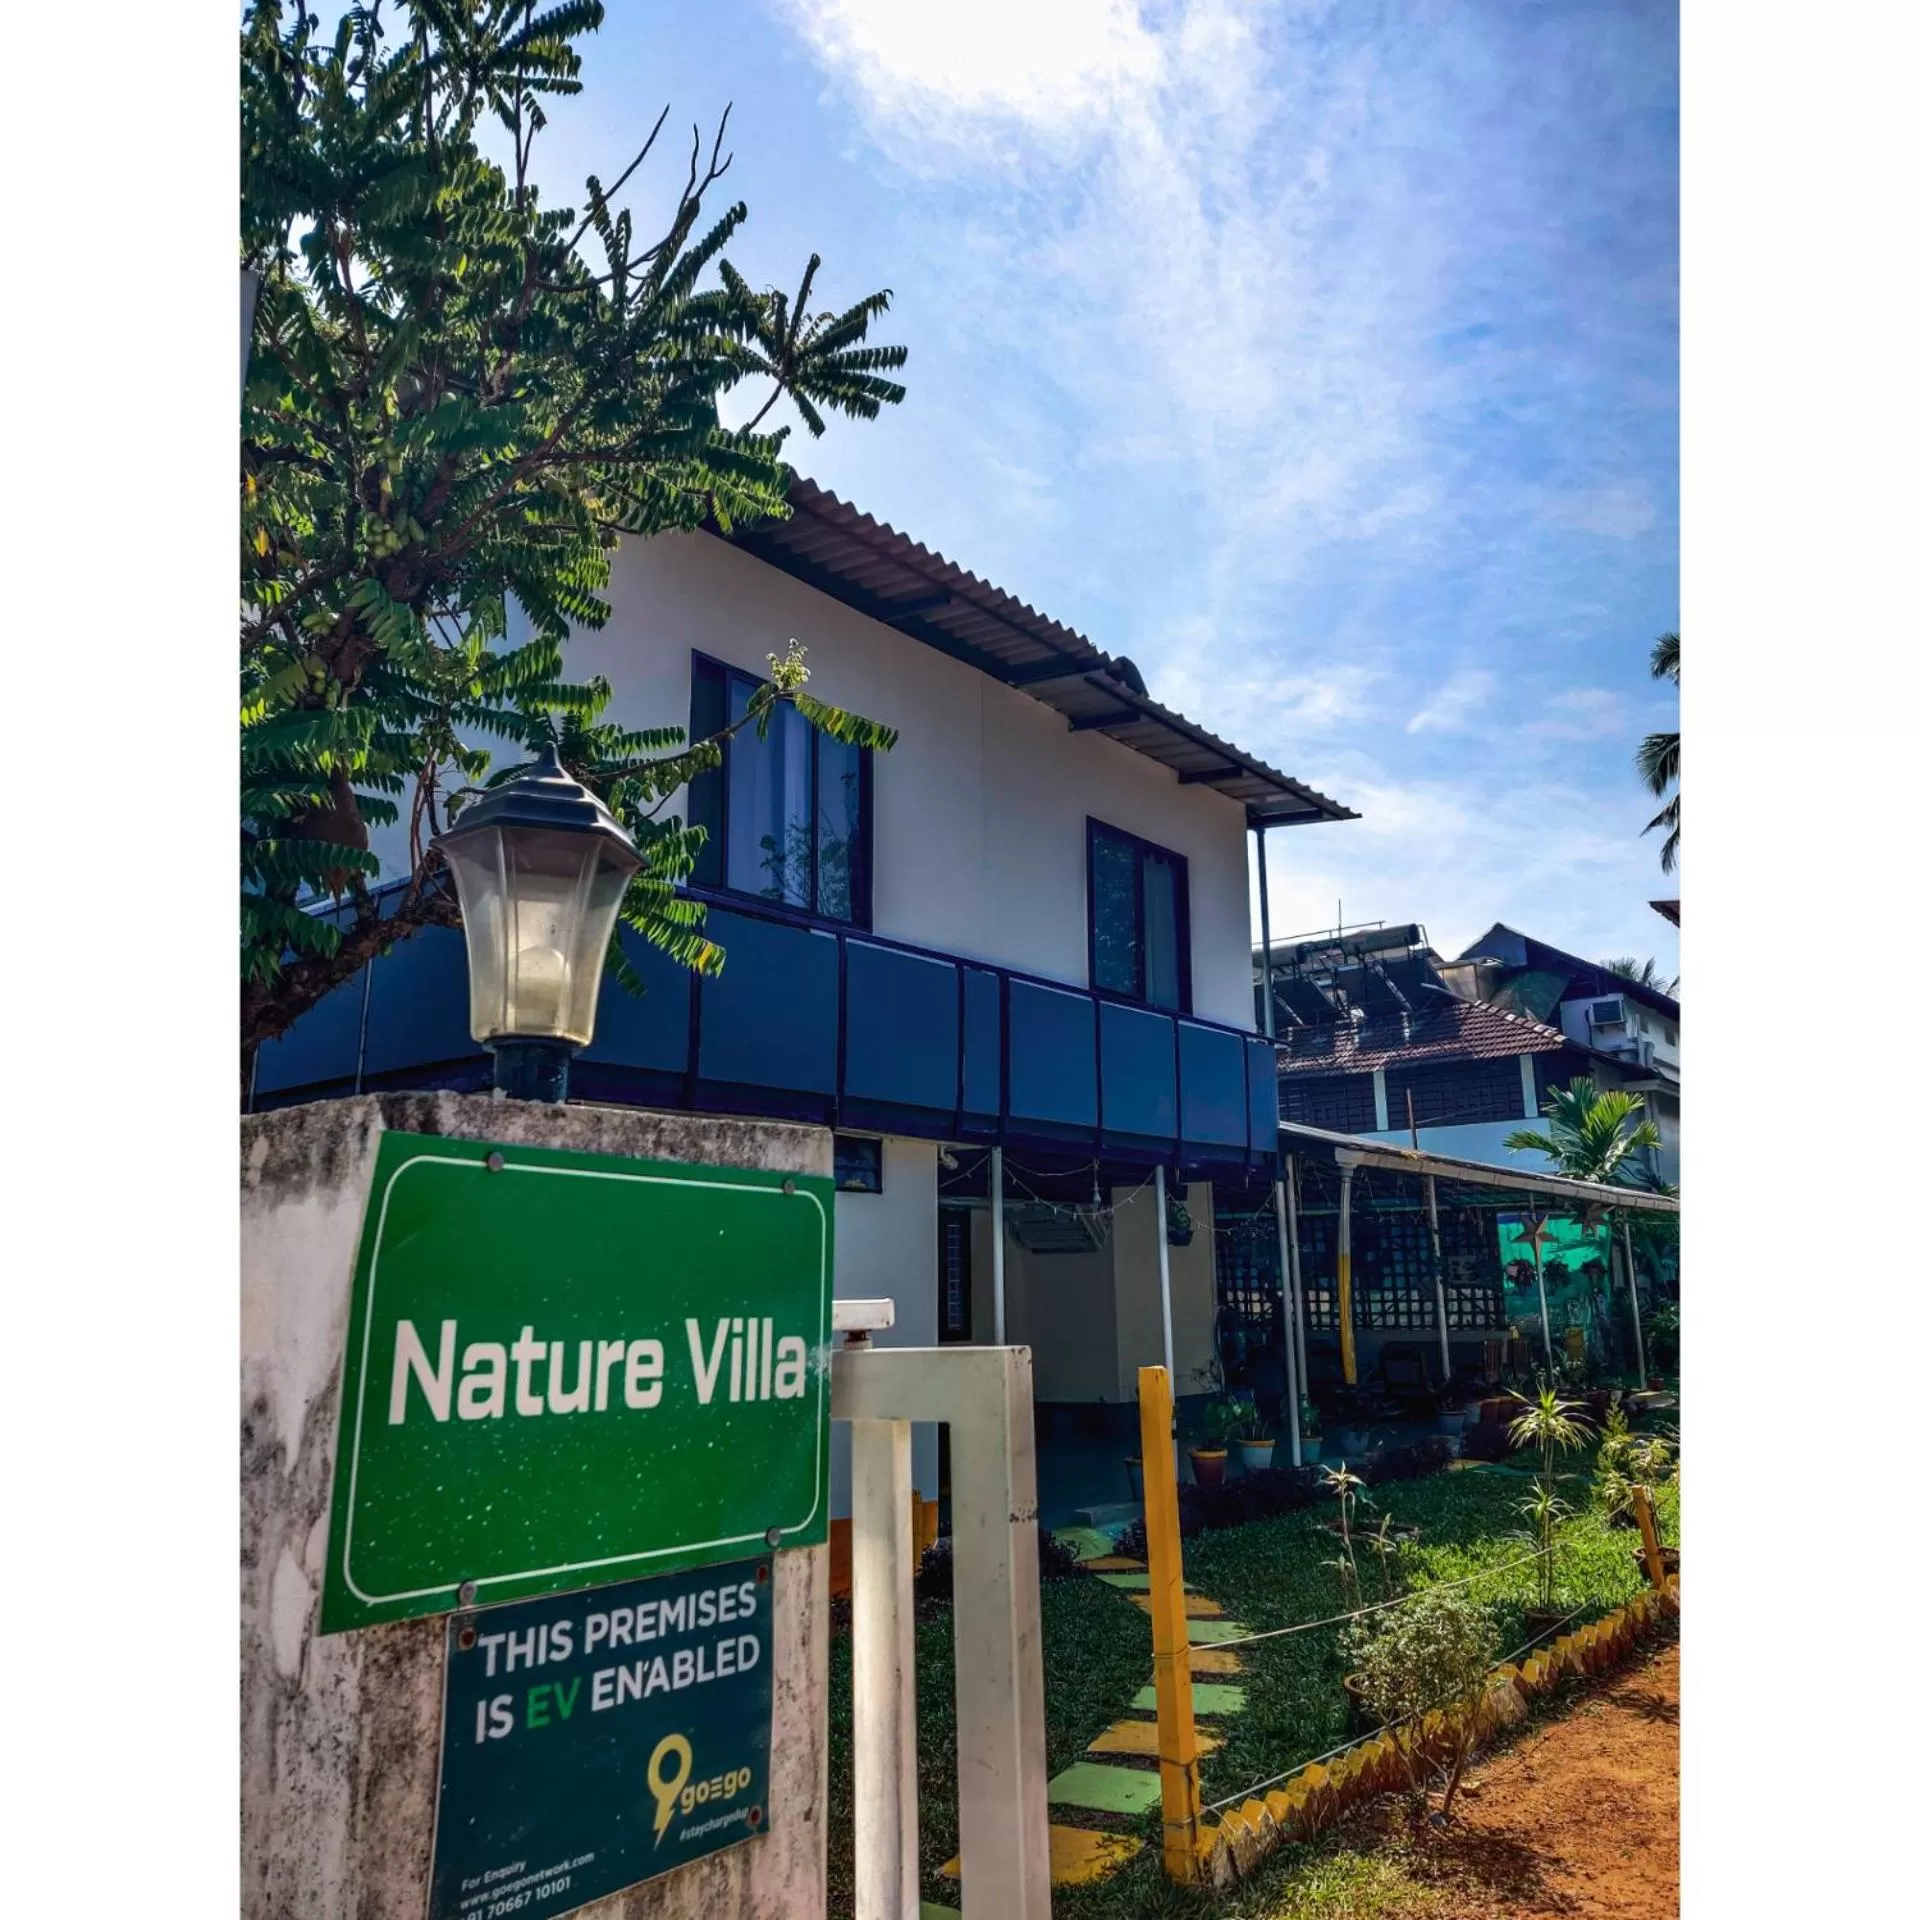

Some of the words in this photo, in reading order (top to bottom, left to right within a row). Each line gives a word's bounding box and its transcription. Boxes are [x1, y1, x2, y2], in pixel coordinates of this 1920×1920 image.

[388, 1319, 664, 1425] Nature
[685, 1317, 807, 1404] Villa
[479, 1621, 573, 1677] THIS
[584, 1582, 757, 1655] PREMISES
[475, 1695, 514, 1744] IS
[526, 1677, 581, 1729] EV
[591, 1635, 760, 1712] ENABLED
[461, 1877, 482, 1892] For
[483, 1860, 527, 1884] Enquiry
[536, 1875, 572, 1902] 10101
